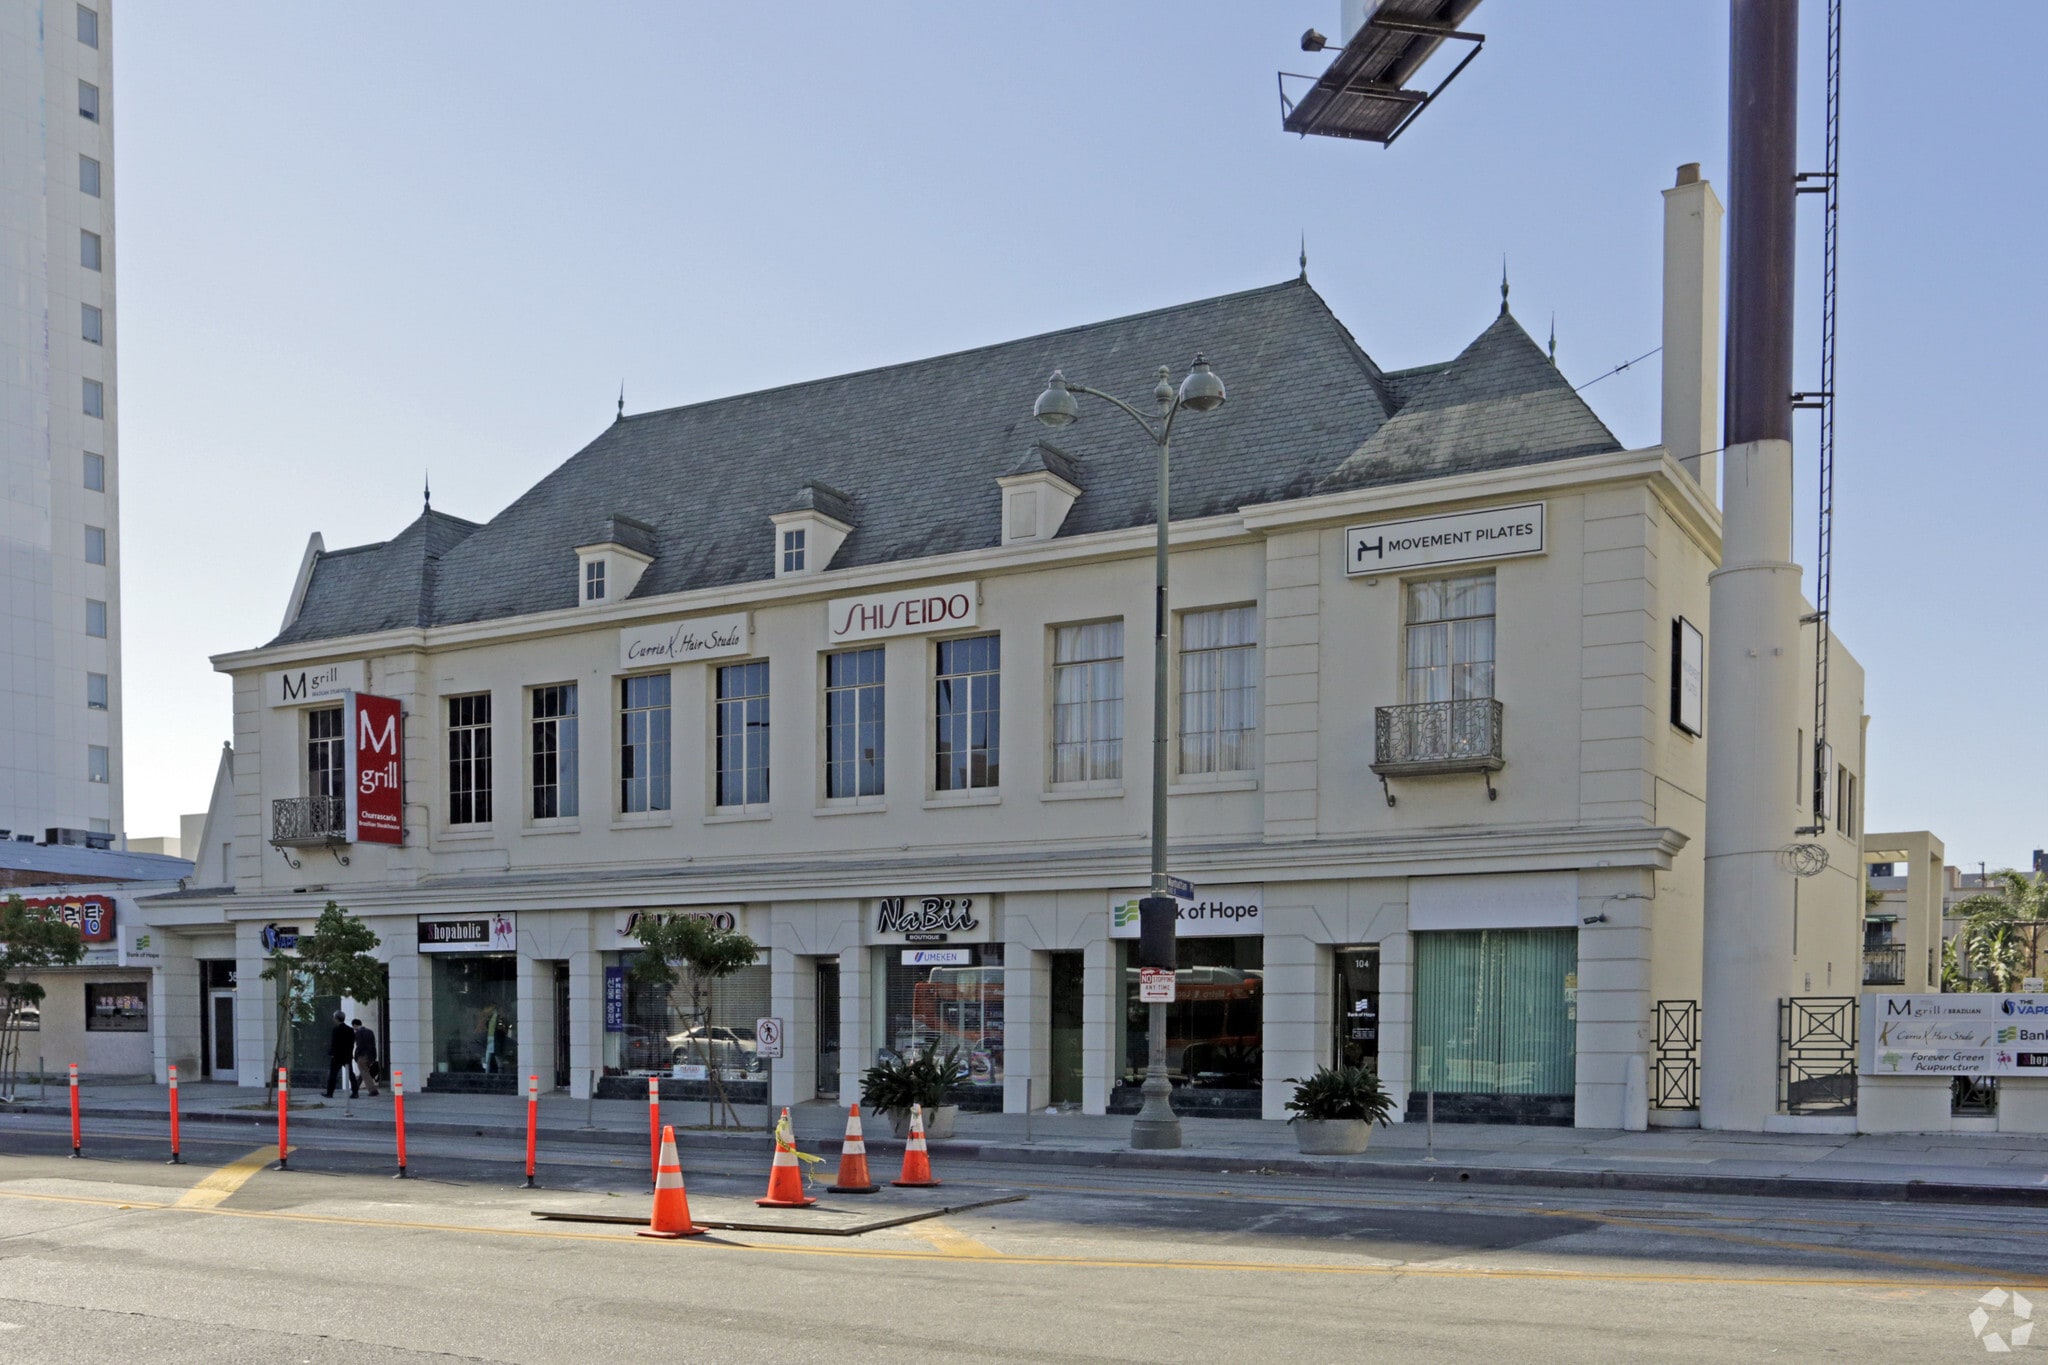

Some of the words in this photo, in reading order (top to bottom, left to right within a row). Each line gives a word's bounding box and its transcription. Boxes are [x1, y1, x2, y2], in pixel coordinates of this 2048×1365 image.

[1388, 531, 1472, 552] MOVEMENT
[1476, 523, 1533, 542] PILATES
[834, 594, 969, 635] SHISEIDO
[680, 633, 703, 652] Hair
[704, 625, 740, 649] Studio
[283, 672, 307, 700] M
[311, 668, 337, 689] grill
[360, 709, 397, 755] M
[360, 761, 398, 794] grill
[361, 810, 397, 822] Churrascaria
[877, 897, 979, 934] NaBii
[1188, 902, 1206, 919] of
[1210, 901, 1258, 922] Hope
[428, 922, 481, 942] Shopaholic
[924, 952, 957, 961] UMEKEN
[1355, 960, 1369, 968] 104
[1141, 975, 1152, 983] NO
[1887, 999, 1911, 1016] M
[1914, 1005, 1940, 1018] grill
[2017, 1006, 2048, 1015] VAPE
[1911, 1052, 1950, 1061] Forever
[1953, 1051, 1984, 1061] Green
[1914, 1062, 1980, 1073] Acupuncture
